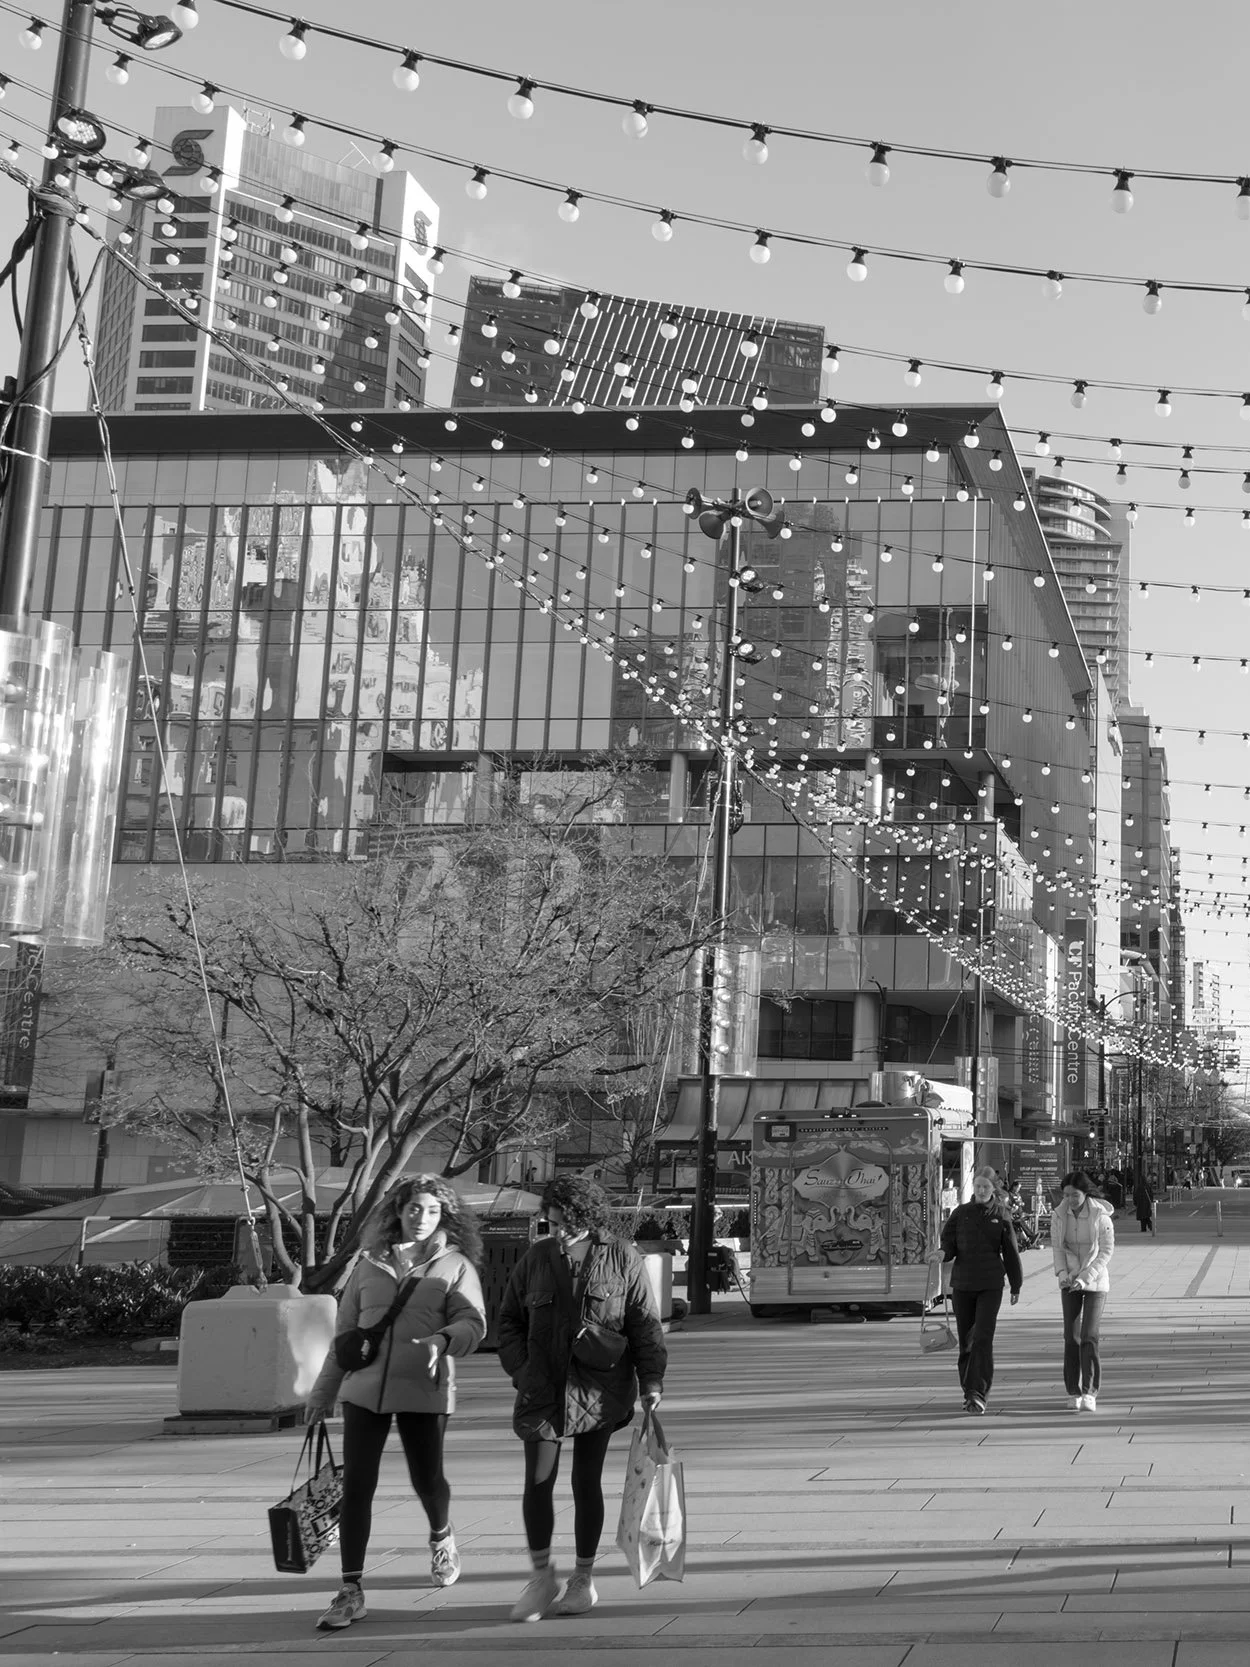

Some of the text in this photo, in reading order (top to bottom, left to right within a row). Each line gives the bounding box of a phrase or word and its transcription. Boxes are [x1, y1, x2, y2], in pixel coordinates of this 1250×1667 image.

[20, 974, 38, 1049] Centre
[1067, 1026, 1081, 1084] Centre
[804, 1169, 844, 1187] Sauz
